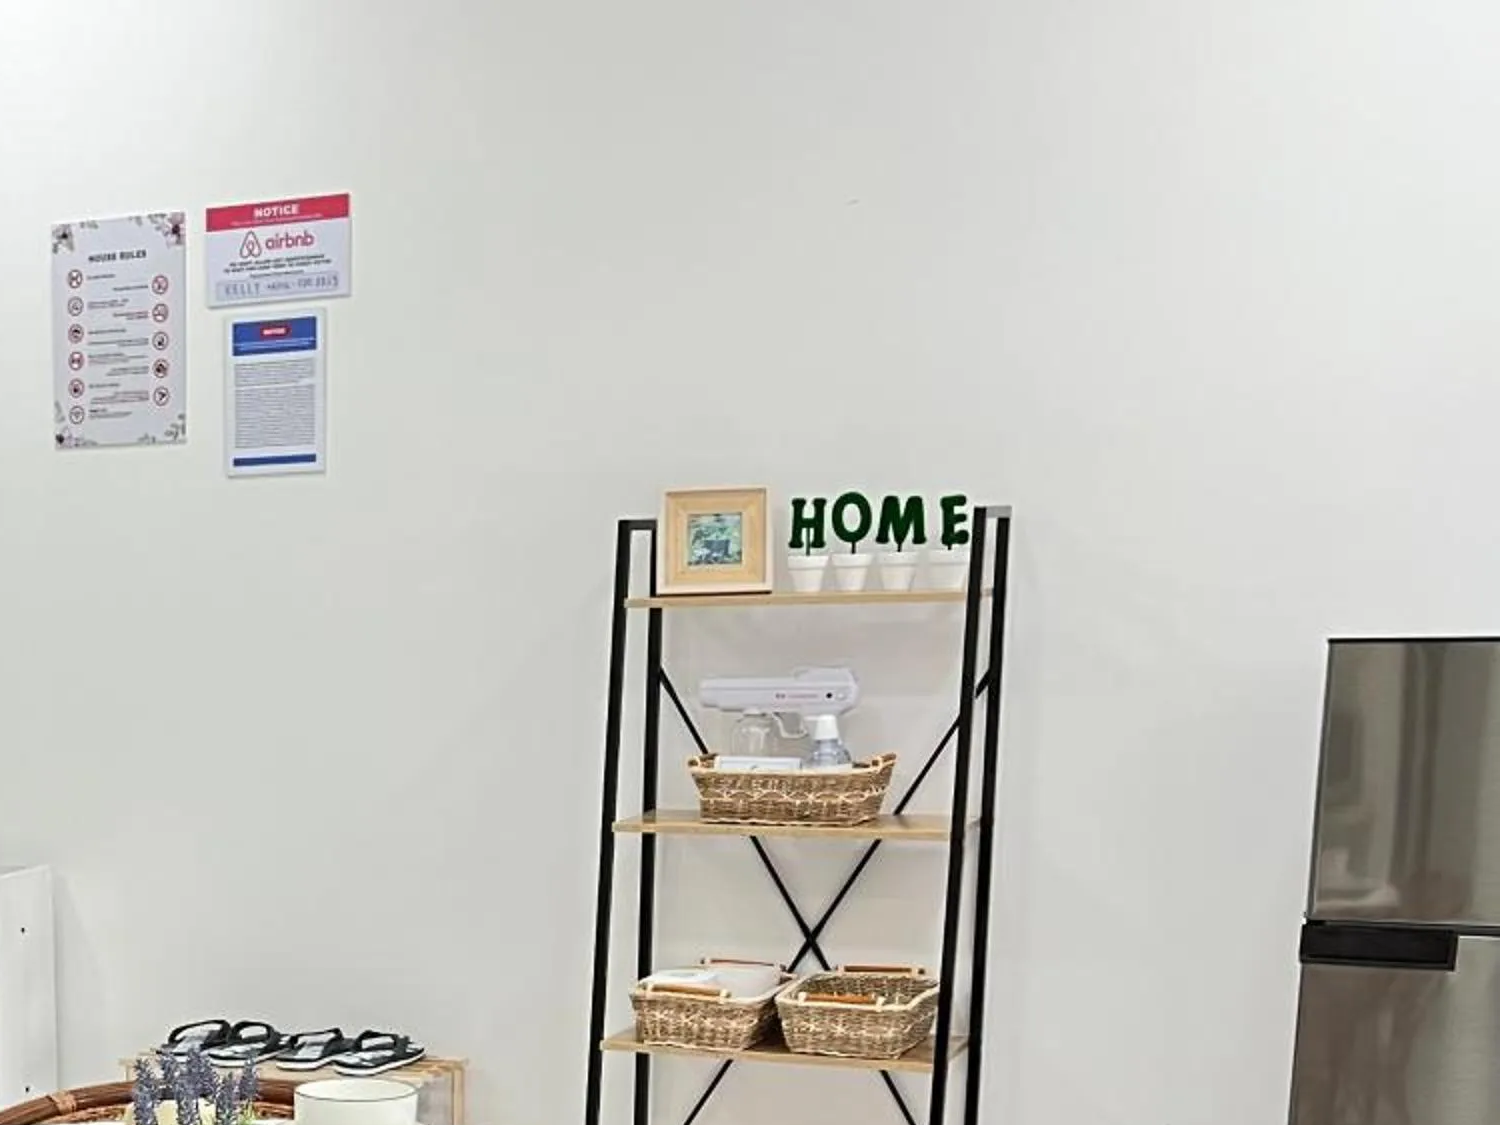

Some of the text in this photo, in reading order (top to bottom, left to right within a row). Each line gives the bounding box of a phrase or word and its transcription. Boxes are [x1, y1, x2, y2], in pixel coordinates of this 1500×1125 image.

[253, 203, 301, 218] NOTICE
[264, 229, 315, 251] airbnb
[789, 491, 971, 551] HOME
